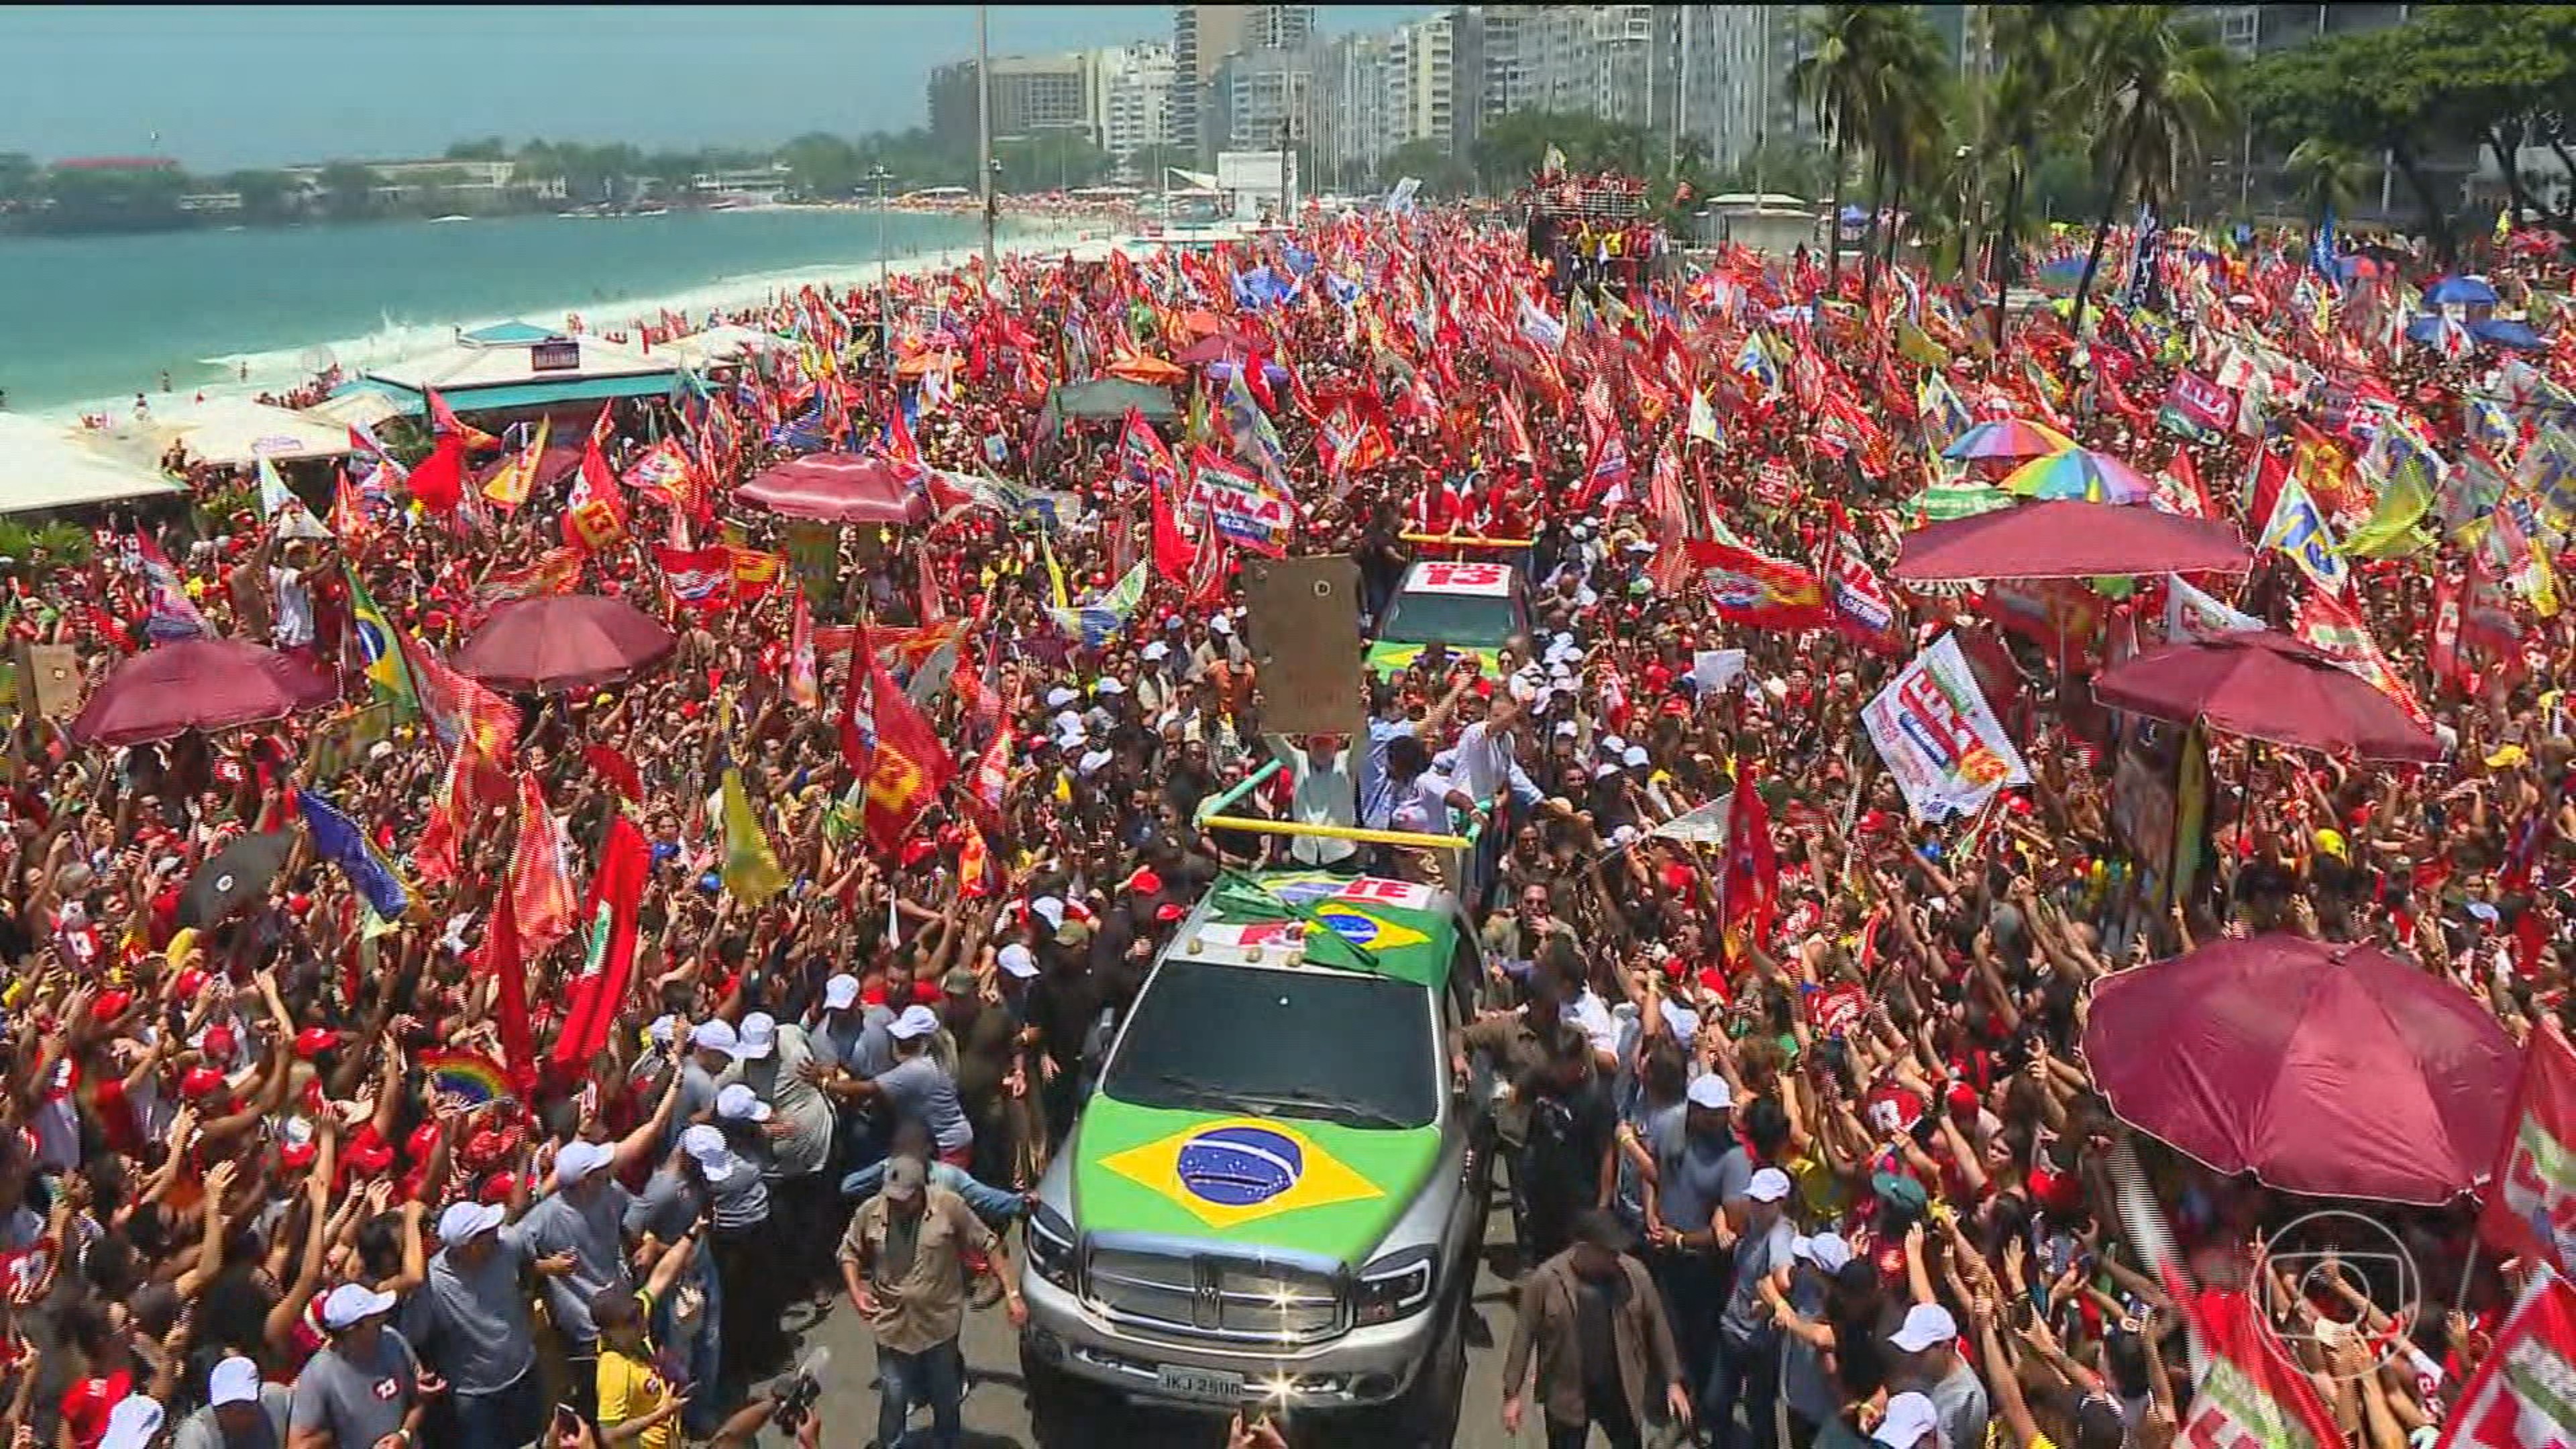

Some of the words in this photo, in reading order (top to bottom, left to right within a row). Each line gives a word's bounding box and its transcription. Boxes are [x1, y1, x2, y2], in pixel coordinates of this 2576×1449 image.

[1193, 484, 1281, 521] LULA
[1427, 570, 1500, 586] 13
[1907, 672, 1974, 755] LULA
[1346, 879, 1411, 898] TE
